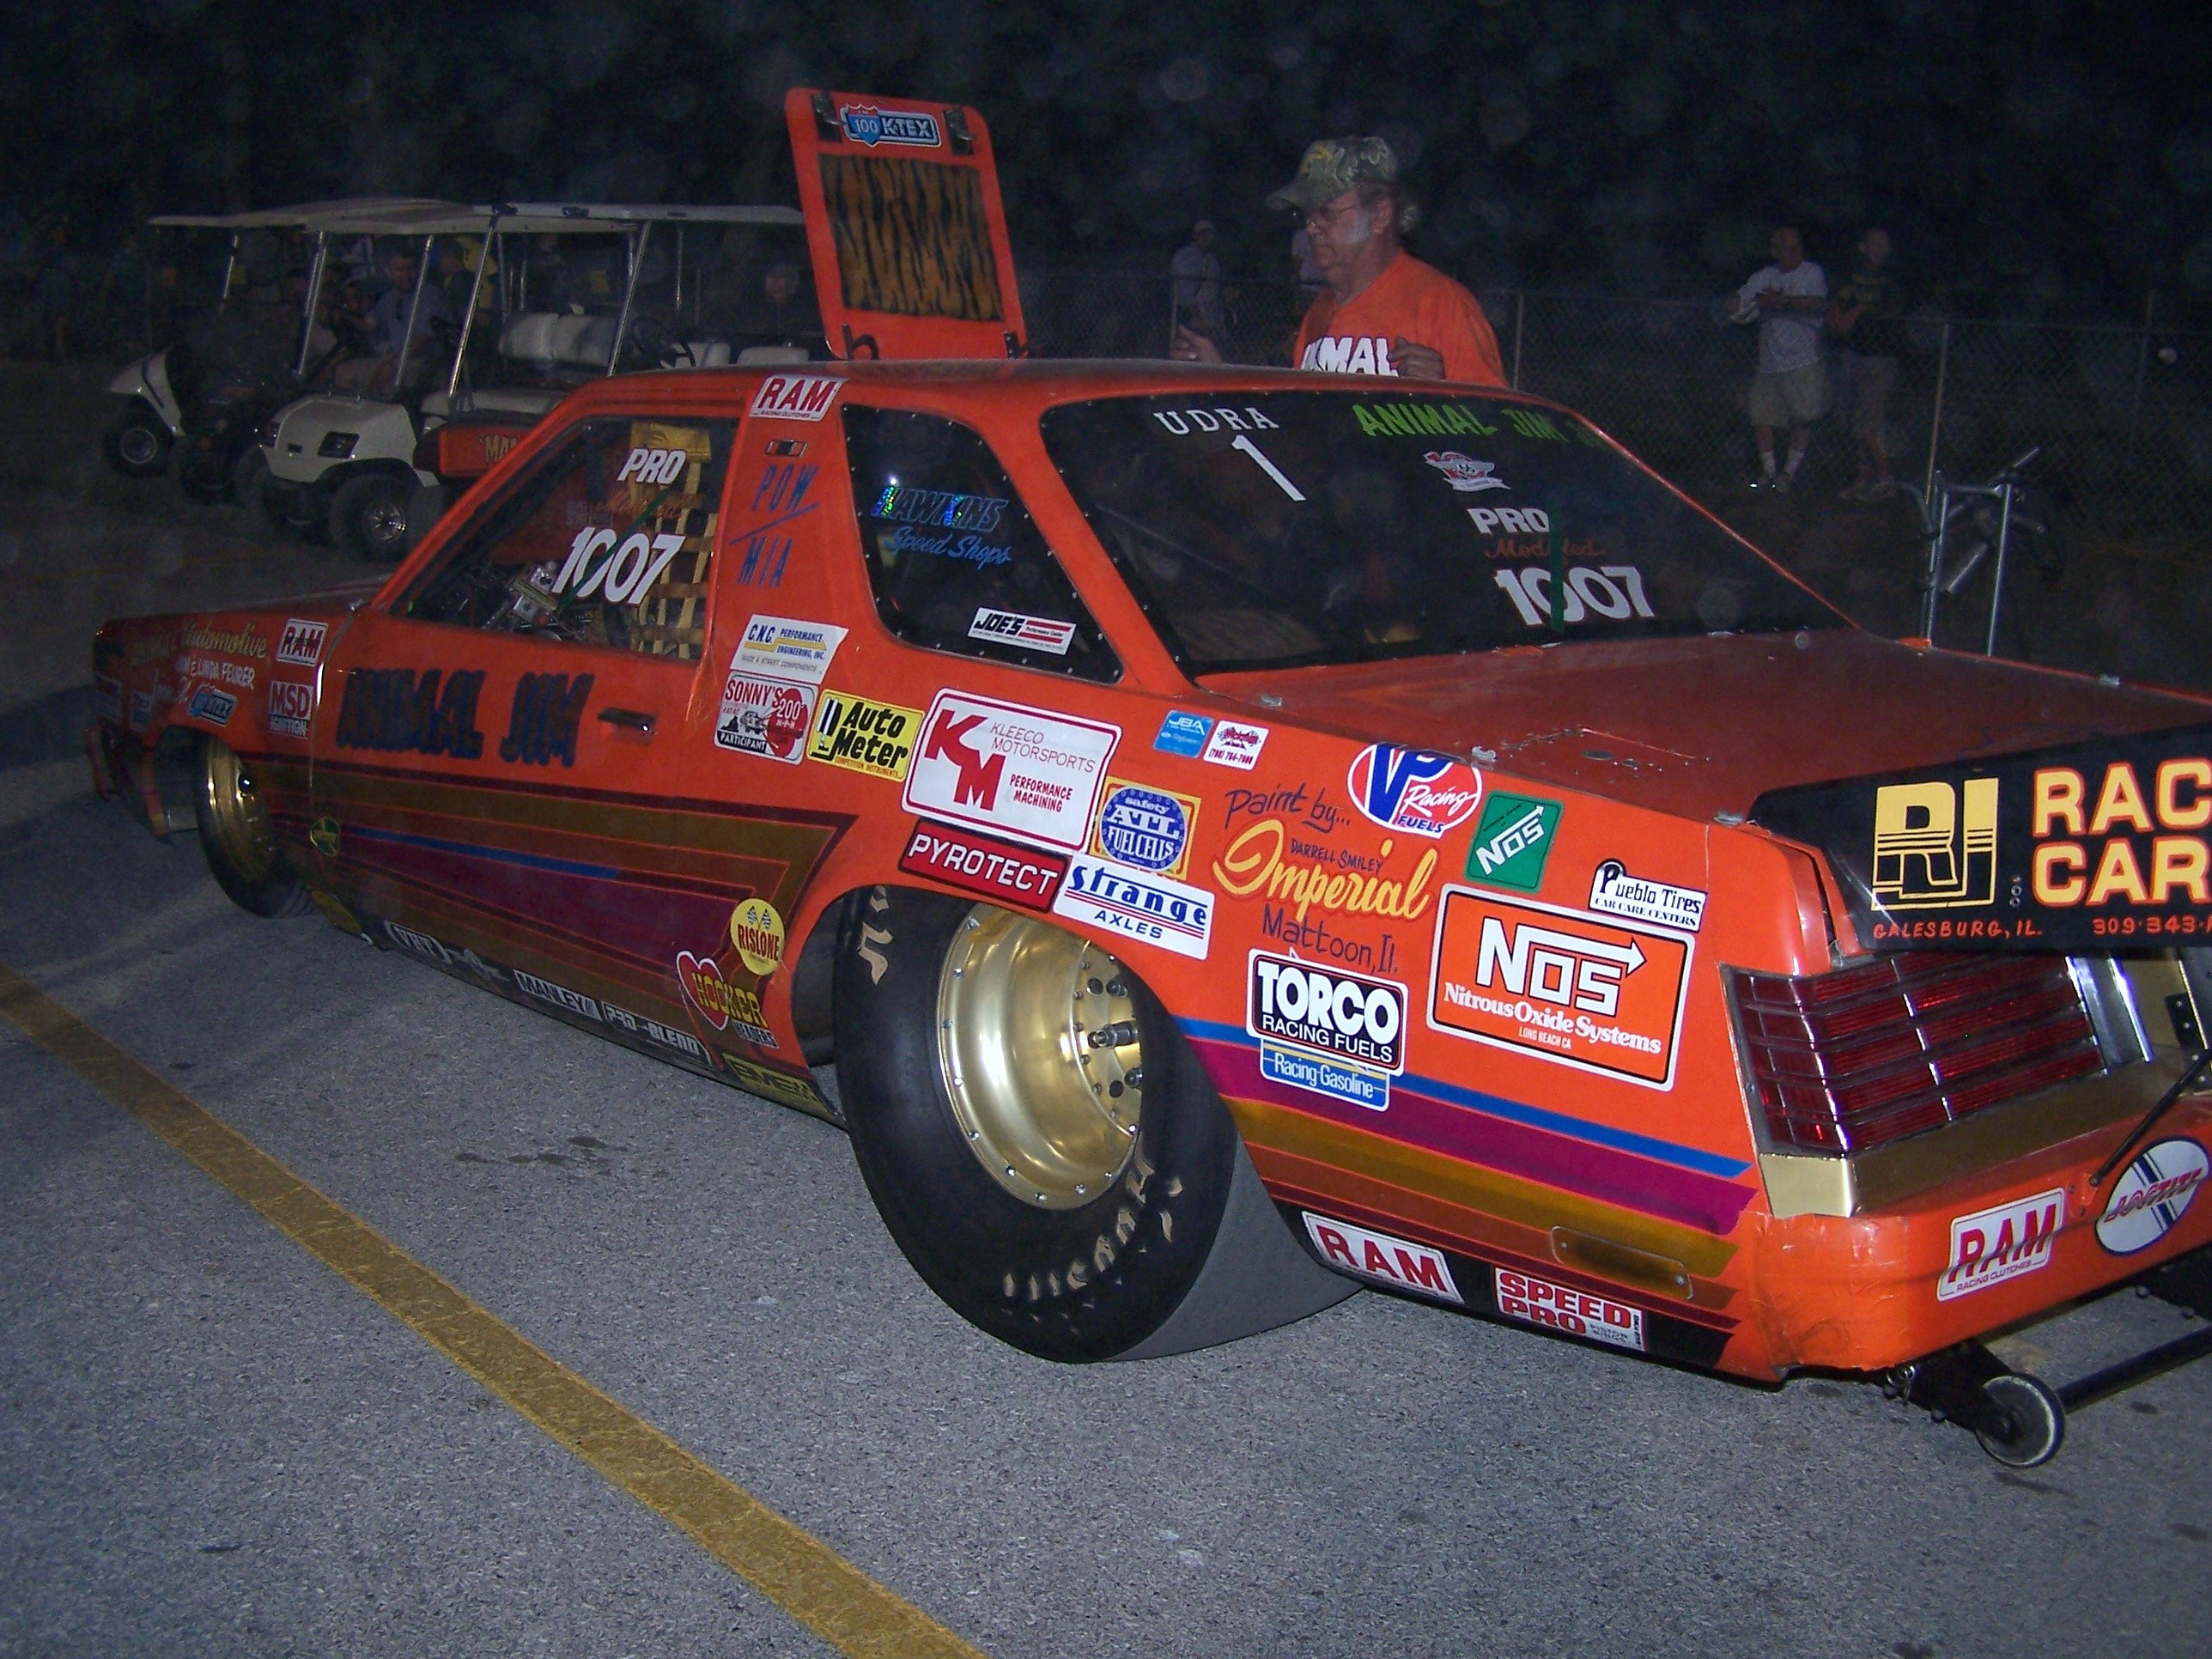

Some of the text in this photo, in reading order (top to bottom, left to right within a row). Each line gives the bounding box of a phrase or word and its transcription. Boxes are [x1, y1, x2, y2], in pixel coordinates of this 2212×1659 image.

[854, 118, 878, 134] 100
[757, 378, 837, 411] RAM
[1152, 407, 1280, 435] UDRA
[1352, 404, 1498, 437] ANIMAL
[617, 447, 687, 486] PRO
[1231, 434, 1306, 501] 1
[1467, 507, 1550, 535] PRO
[551, 526, 687, 605] 1007
[1494, 565, 1655, 627] 1007
[974, 613, 1025, 635] JOE'S
[279, 626, 324, 659] RAM
[270, 683, 313, 720] MSD
[725, 678, 783, 709] SONNY'S
[776, 697, 802, 721] 200
[843, 702, 906, 738] Auto
[990, 722, 1044, 744] KLEECO
[1168, 717, 1206, 736] JBA
[719, 732, 767, 752] PARTICIPANT
[834, 728, 908, 769] Meter
[991, 737, 1097, 773] MOTORSPORTS
[1009, 774, 1073, 800] PERFORMANCE
[1013, 790, 1063, 812] MACHINING
[1399, 783, 1479, 817] Racing
[1106, 804, 1180, 840] ATL
[1124, 797, 1170, 814] safety
[1224, 782, 1304, 830] Paint
[1397, 816, 1444, 833] FUELS
[1475, 803, 1545, 876] NOS
[1108, 825, 1175, 862] FUEL CELLS
[1290, 838, 1384, 874] DARRELL SMILEY
[908, 833, 1060, 896] PYROTECT
[1212, 818, 1438, 921] Imperial
[1066, 863, 1207, 927] Strange
[1599, 863, 1701, 915] Pueblo Tires
[1093, 909, 1164, 939] AXLES
[1595, 897, 1696, 927] CAR CARE CENTERS
[1872, 918, 2010, 940] GALESBURG,
[738, 923, 780, 962] RISLONE
[1475, 916, 1648, 1017] NOS
[519, 973, 587, 1012] MANLEY
[691, 971, 769, 1029] HOOKER
[1257, 960, 1400, 1045] TORCO
[1443, 981, 1662, 1054] Nitrous Oxide Systems
[1262, 1014, 1393, 1063] RACING FUELS
[1518, 1026, 1571, 1049] LONG BEACH CA
[1274, 1052, 1374, 1099] Racing Gasoline
[1316, 1224, 1449, 1292] RAM
[1947, 1203, 2057, 1284] RAM
[1956, 1260, 2032, 1291] RACING CLUTCHES
[1500, 1273, 1632, 1329] SPEED
[1501, 1295, 1587, 1334] PRO
